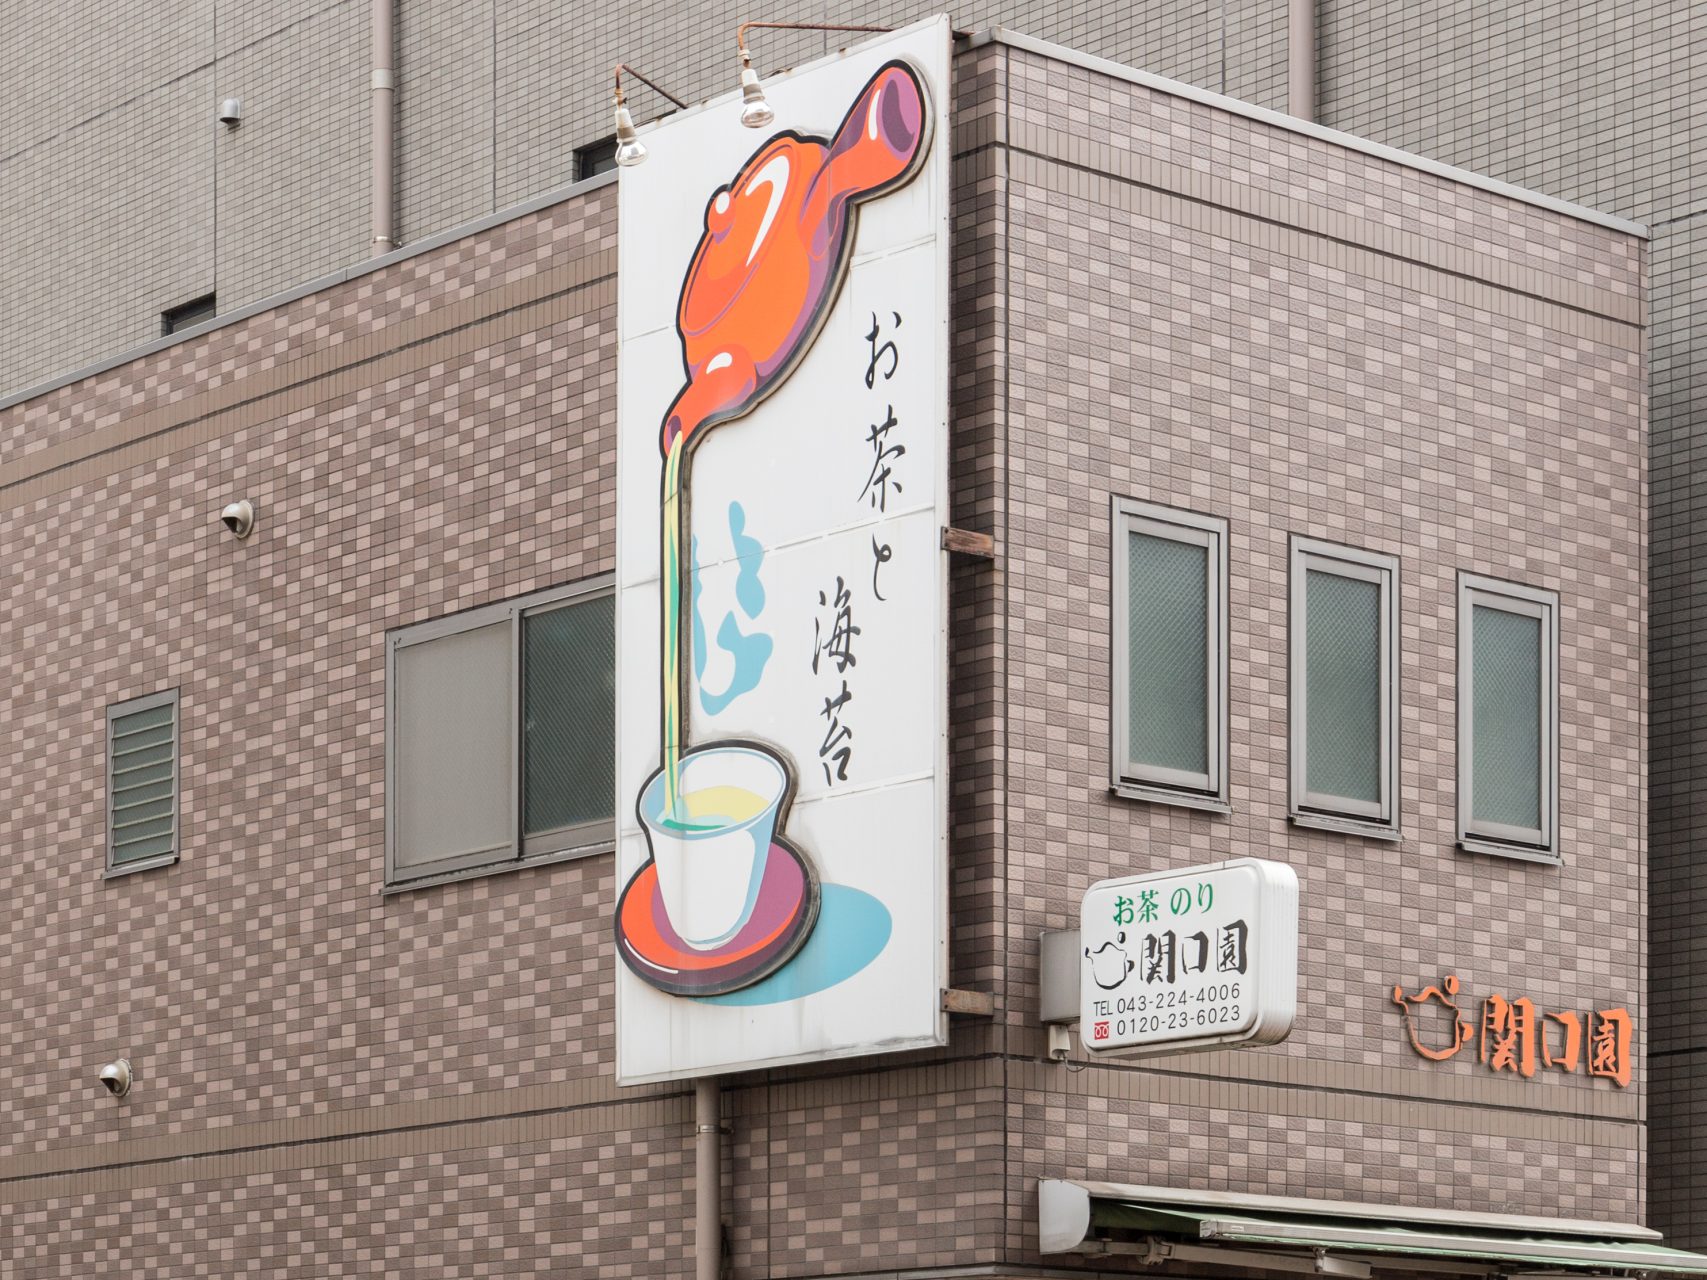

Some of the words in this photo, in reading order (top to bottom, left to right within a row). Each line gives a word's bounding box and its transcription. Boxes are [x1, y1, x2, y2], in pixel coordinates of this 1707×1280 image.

[858, 311, 905, 601] お茶と
[812, 576, 861, 787] 海苔
[1140, 919, 1249, 984] 関口園
[1093, 1000, 1113, 1016] TEL
[1116, 982, 1241, 1014] 043-224-4006
[1116, 1004, 1241, 1036] 0120-23-6023
[1479, 993, 1633, 1088] 関口園
